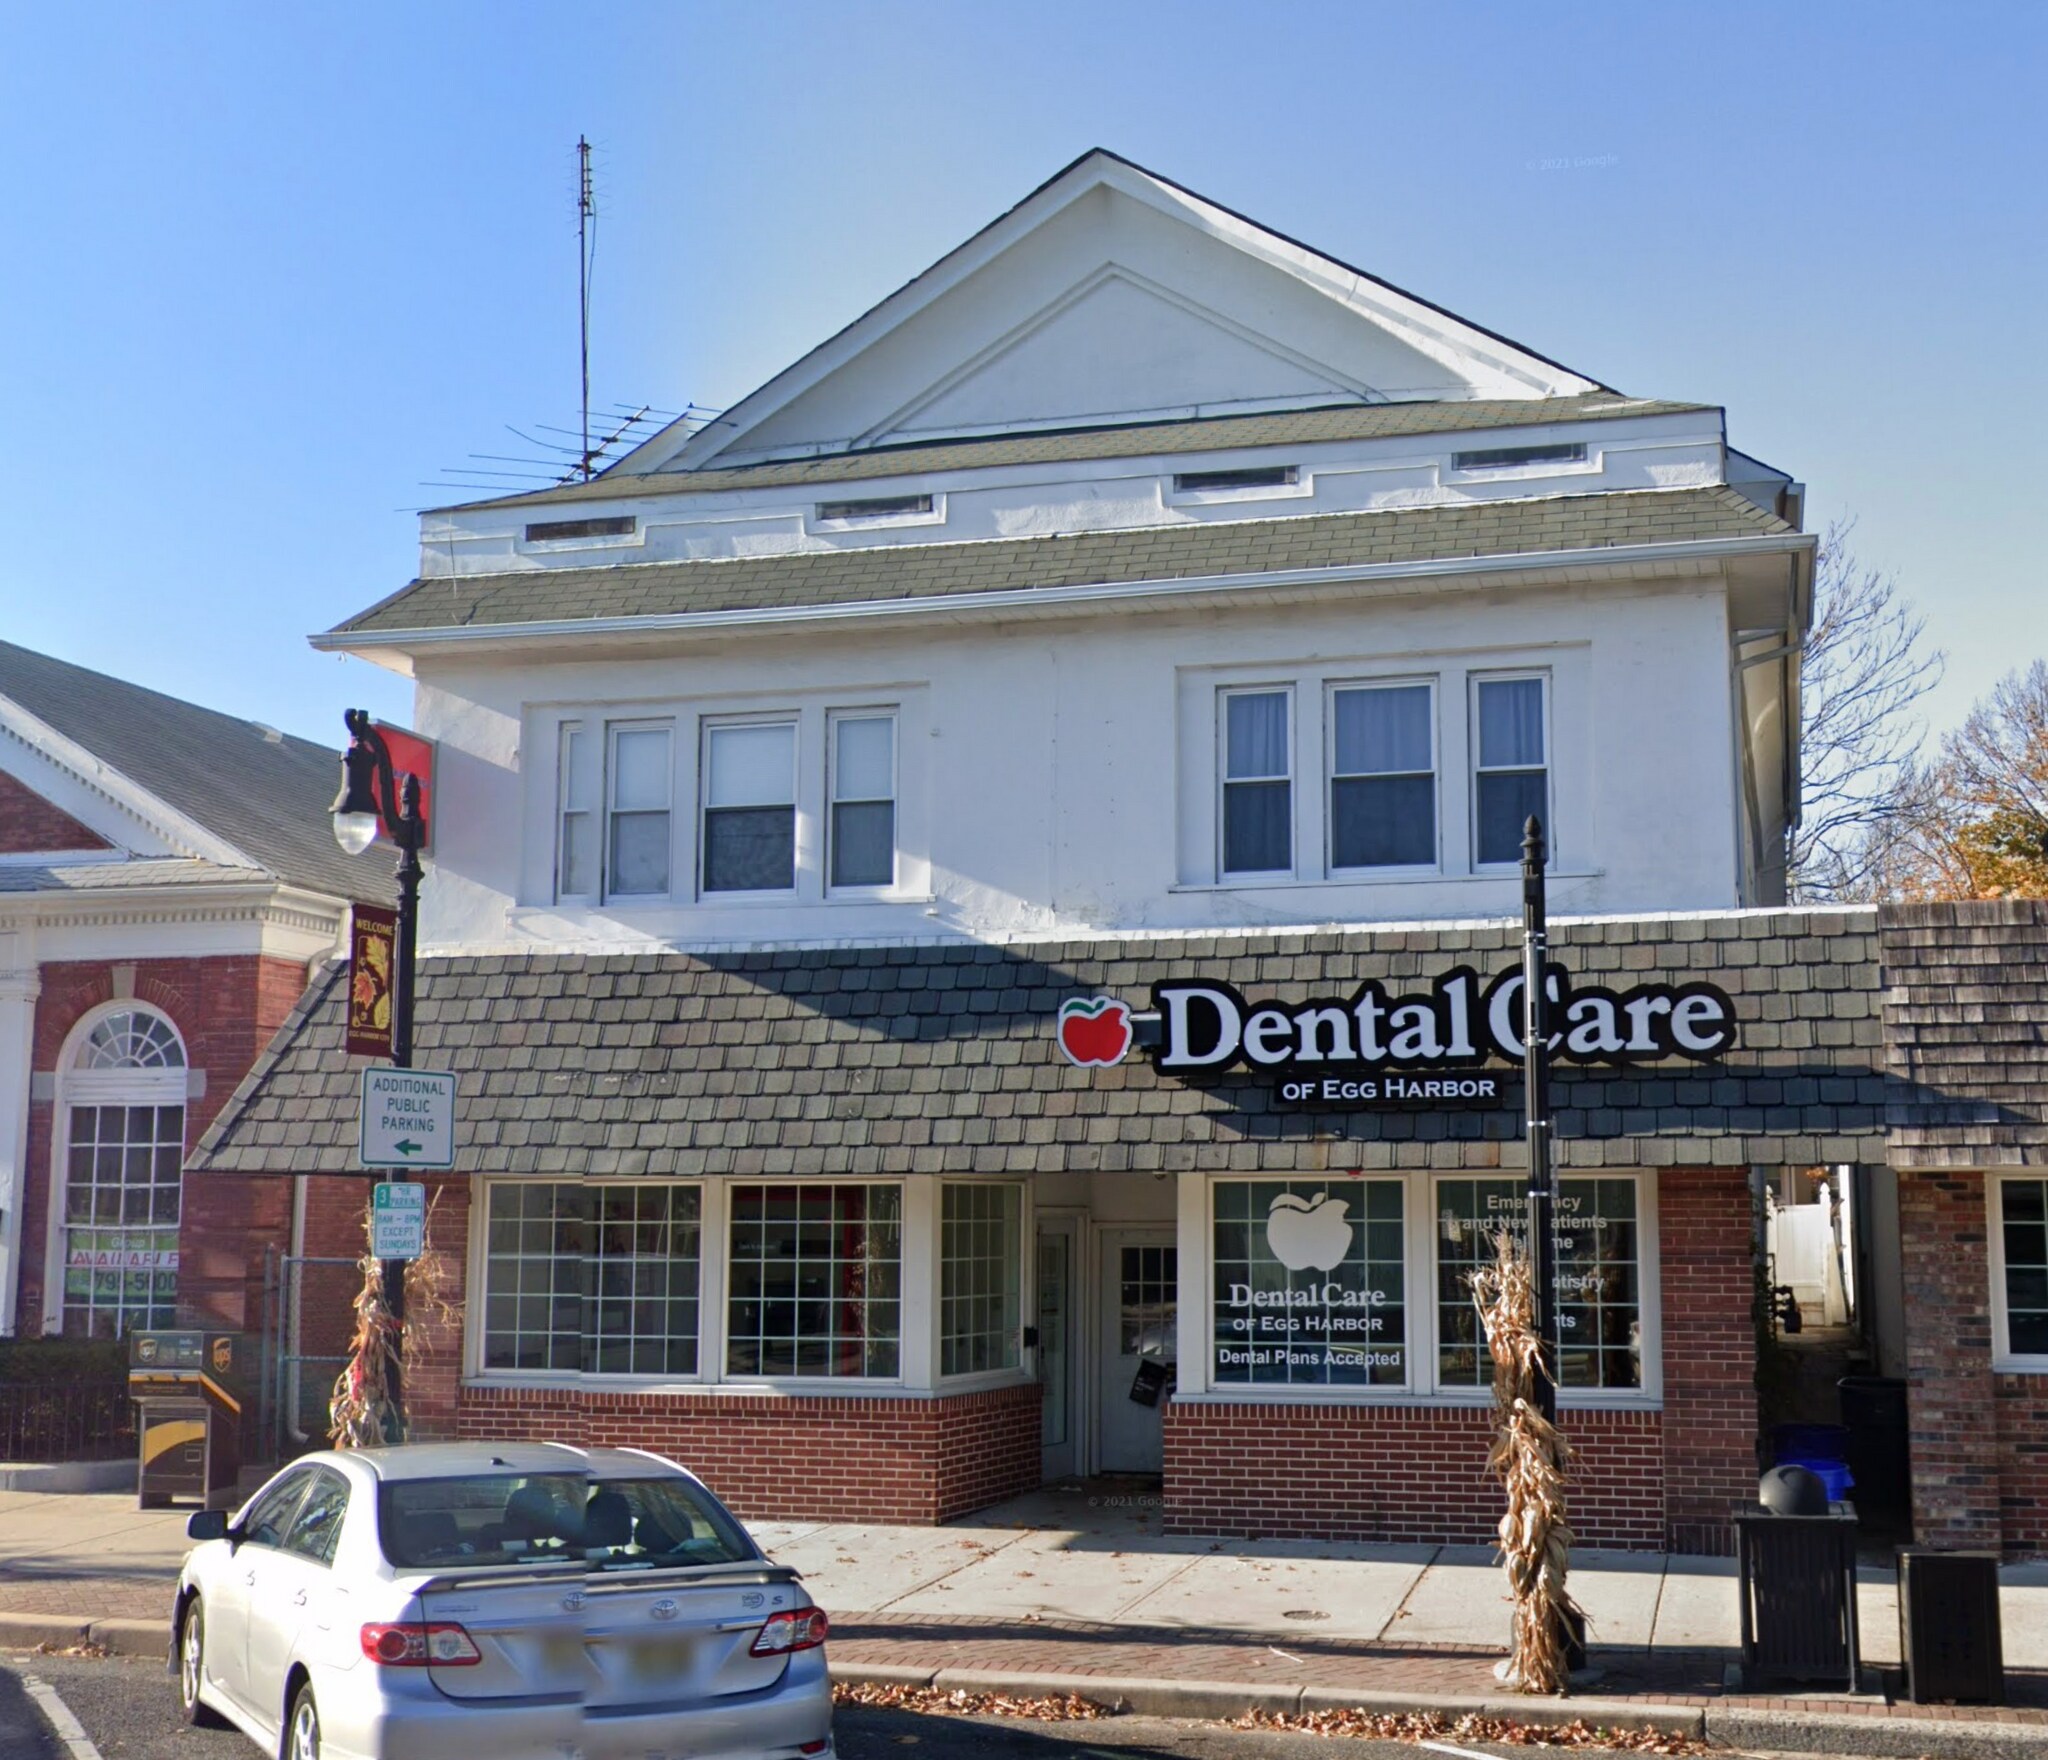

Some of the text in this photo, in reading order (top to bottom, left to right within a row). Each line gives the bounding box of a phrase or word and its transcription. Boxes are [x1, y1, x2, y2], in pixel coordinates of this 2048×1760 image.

[356, 918, 394, 936] WELCOME
[373, 1077, 446, 1096] ADDITIONAL
[1384, 1078, 1496, 1099] HARBOR
[387, 1097, 430, 1113] PUBLIC
[381, 1116, 435, 1132] PARKING
[379, 1188, 387, 1204] 3
[1487, 1195, 1581, 1211] Emerncy
[1462, 1215, 1493, 1229] and
[1550, 1214, 1608, 1229] atients
[382, 1227, 415, 1237] EXCEPT
[379, 1239, 417, 1249] SUNDAYS
[1508, 1235, 1574, 1250] elme
[1305, 1315, 1383, 1331] HARBOR
[1219, 1348, 1400, 1369] Dental Plans Accepted
